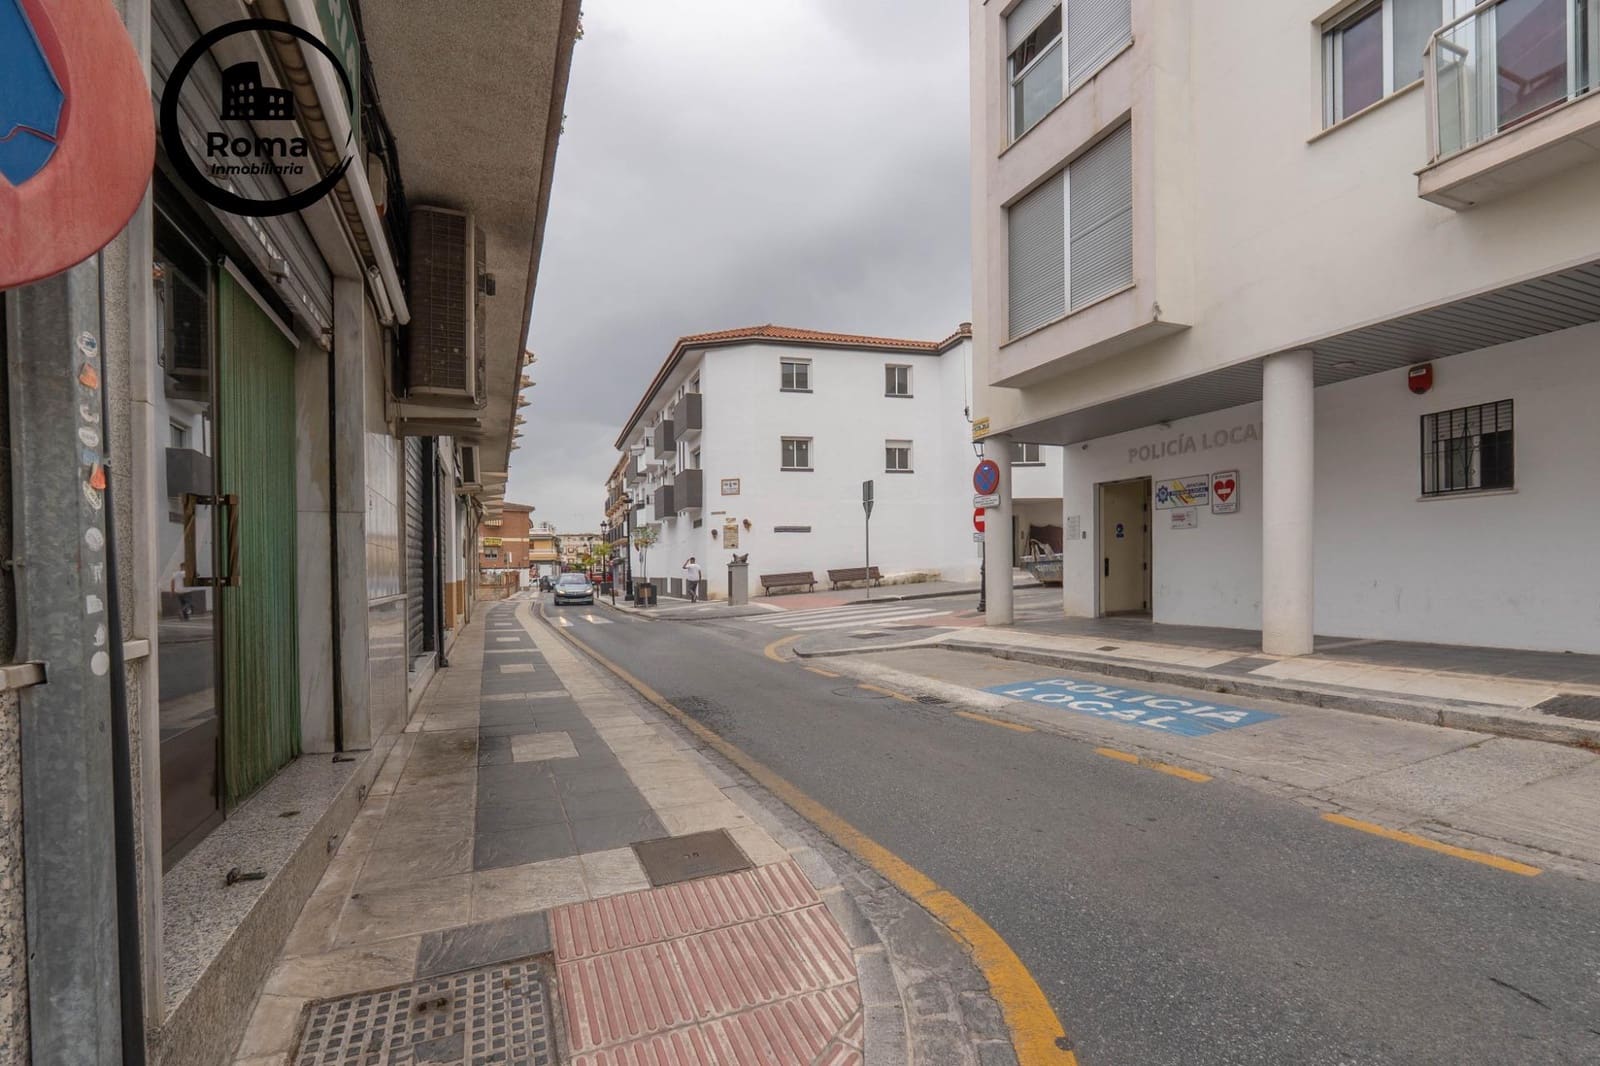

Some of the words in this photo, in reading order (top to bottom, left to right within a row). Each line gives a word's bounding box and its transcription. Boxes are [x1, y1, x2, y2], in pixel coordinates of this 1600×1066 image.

[1128, 433, 1196, 463] POLICÍA
[1003, 687, 1177, 730] LOCAL
[1035, 679, 1250, 723] POLICIA
